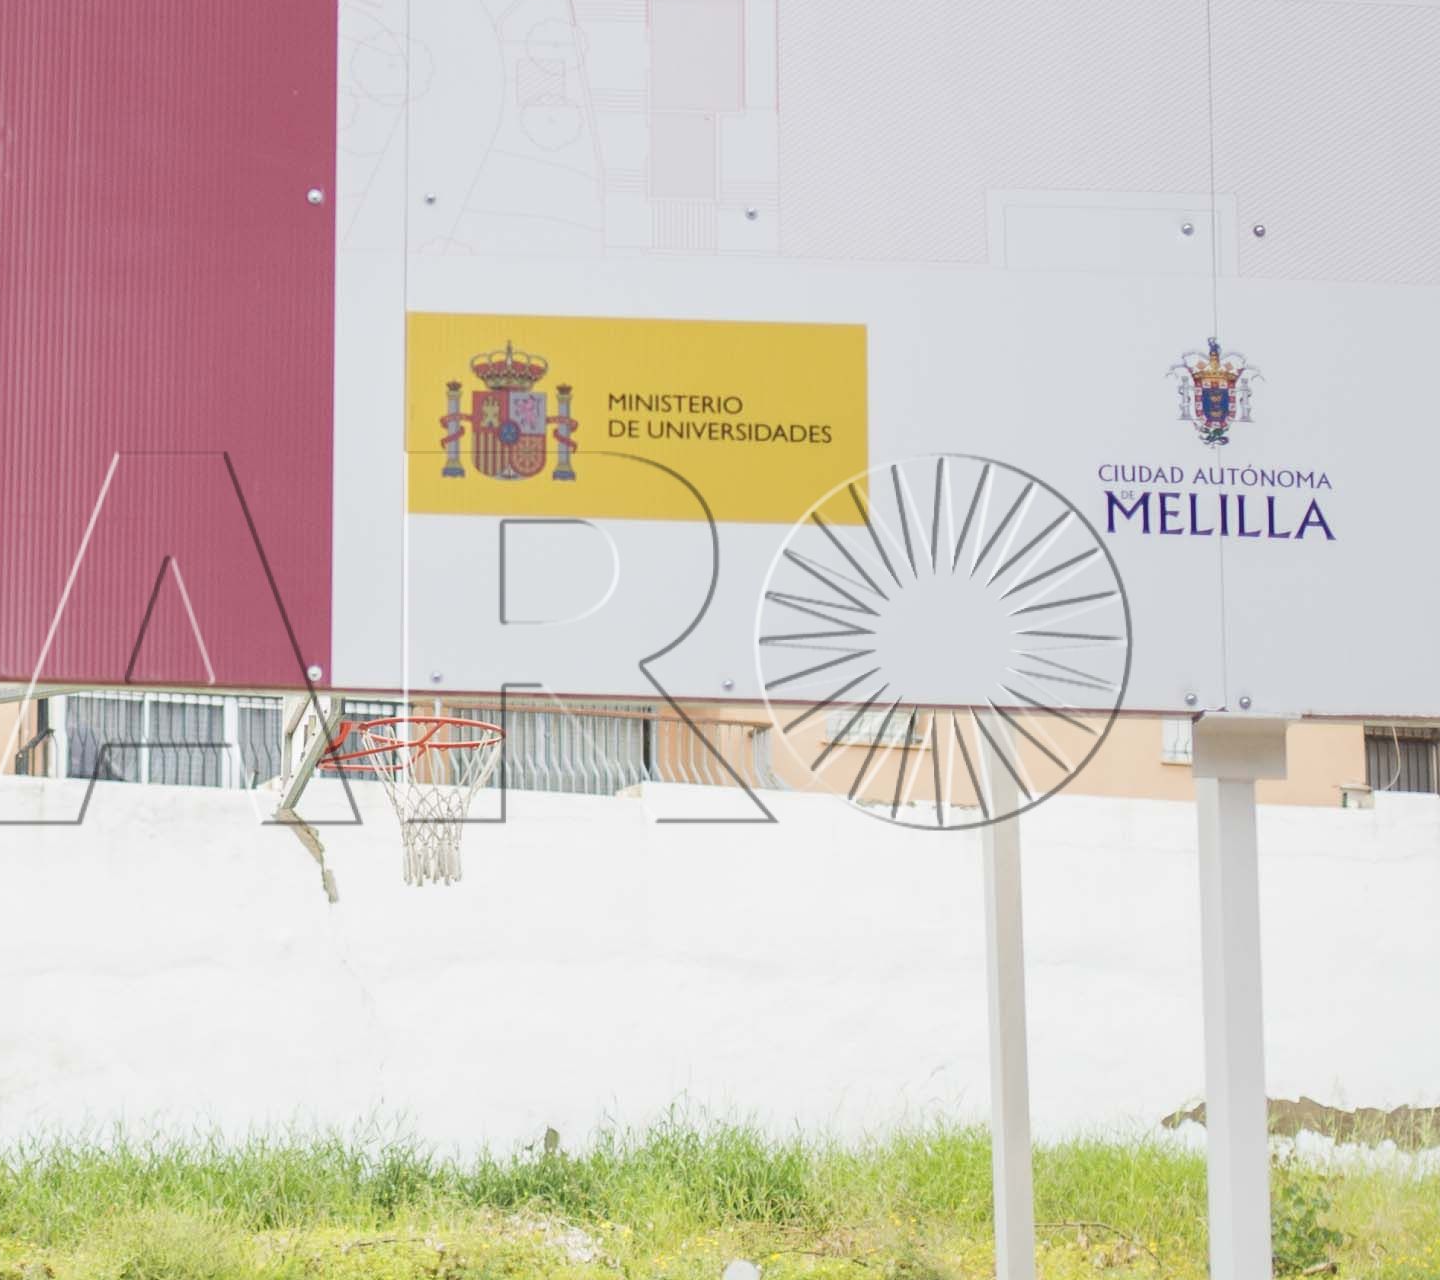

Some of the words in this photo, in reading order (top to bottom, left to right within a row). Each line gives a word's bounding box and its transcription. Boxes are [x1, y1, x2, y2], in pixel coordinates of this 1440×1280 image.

[609, 393, 743, 414] MINISTERIO
[609, 420, 639, 438] DE
[648, 421, 832, 443] UNIVERSIDADES
[1098, 464, 1184, 484] CIUDAD
[1192, 464, 1332, 489] AUTÓNOMA
[1104, 490, 1336, 540] MELILLA
